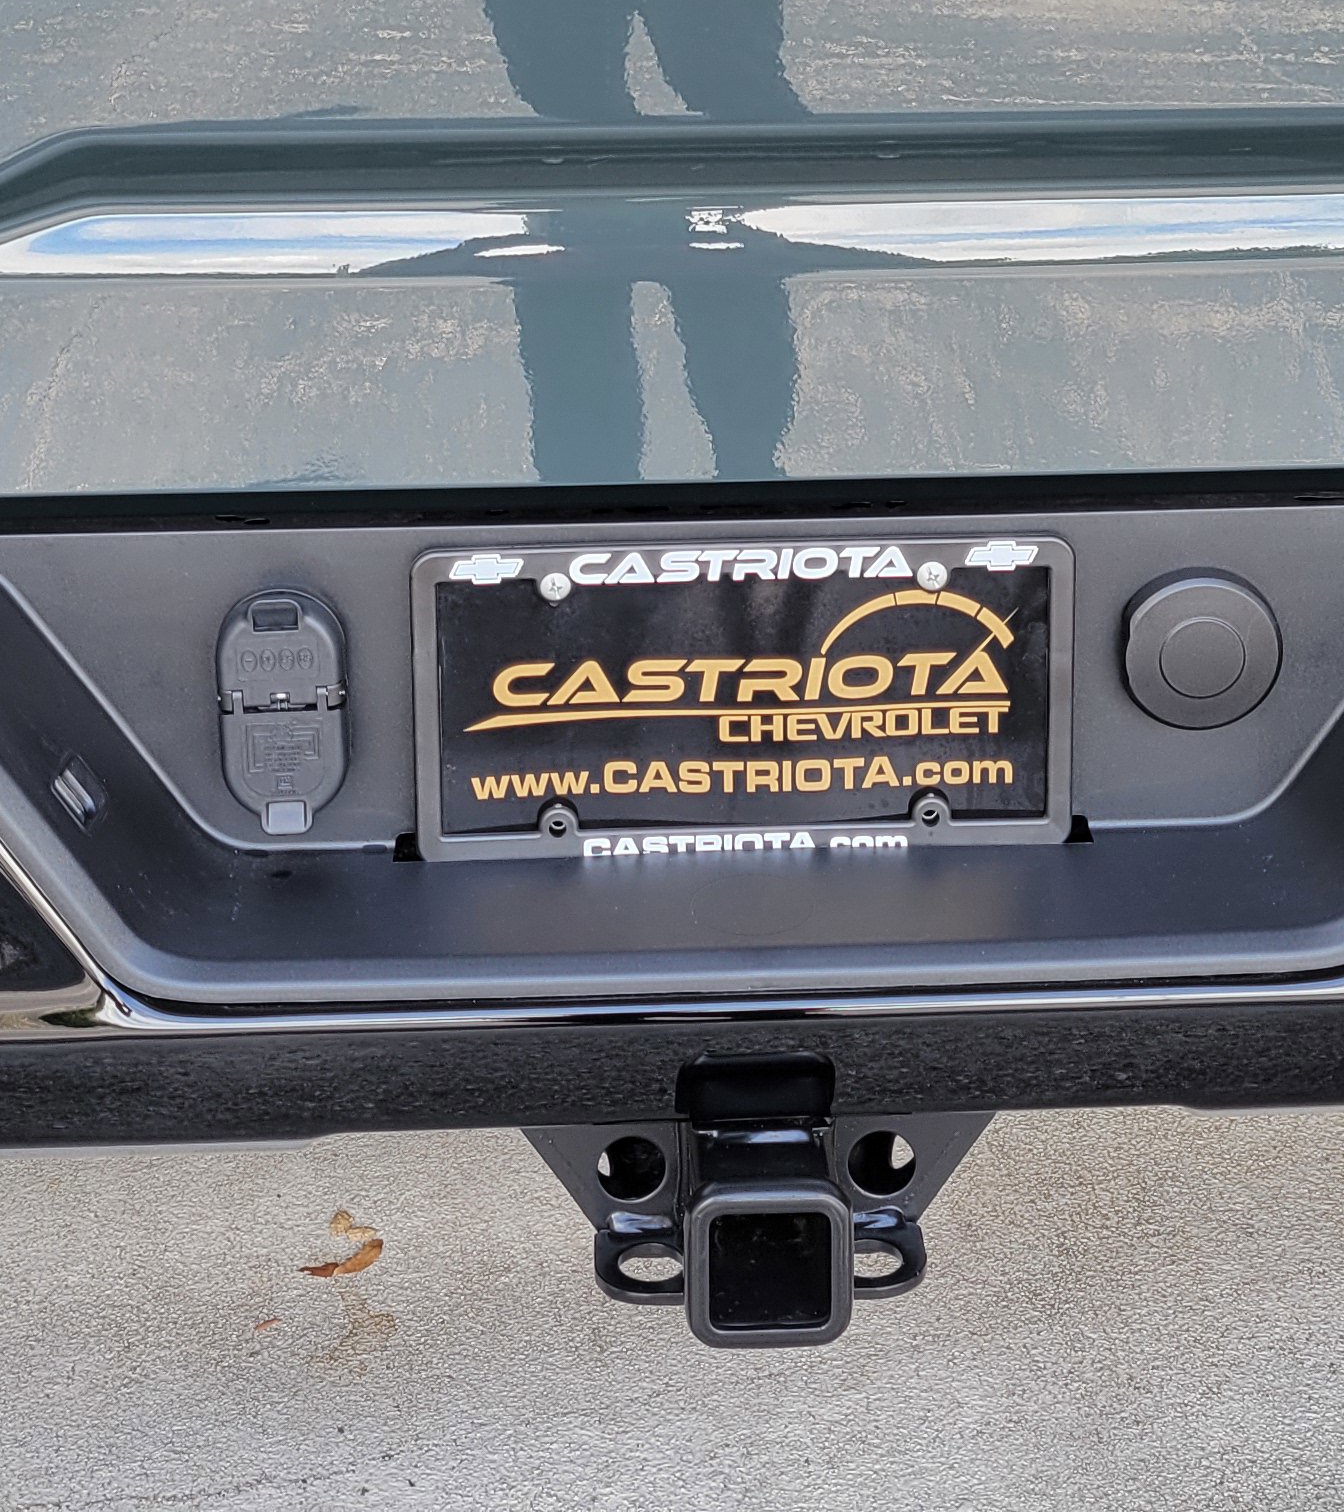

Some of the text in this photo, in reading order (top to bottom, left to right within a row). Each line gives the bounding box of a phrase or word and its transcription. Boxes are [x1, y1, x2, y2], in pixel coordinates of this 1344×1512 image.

[567, 546, 914, 585] CASTRIOTA
[492, 651, 1009, 707] CASTRIOTA
[718, 705, 1010, 743] CHEVROLET
[470, 755, 1014, 801] www.CASTRIOTA.com
